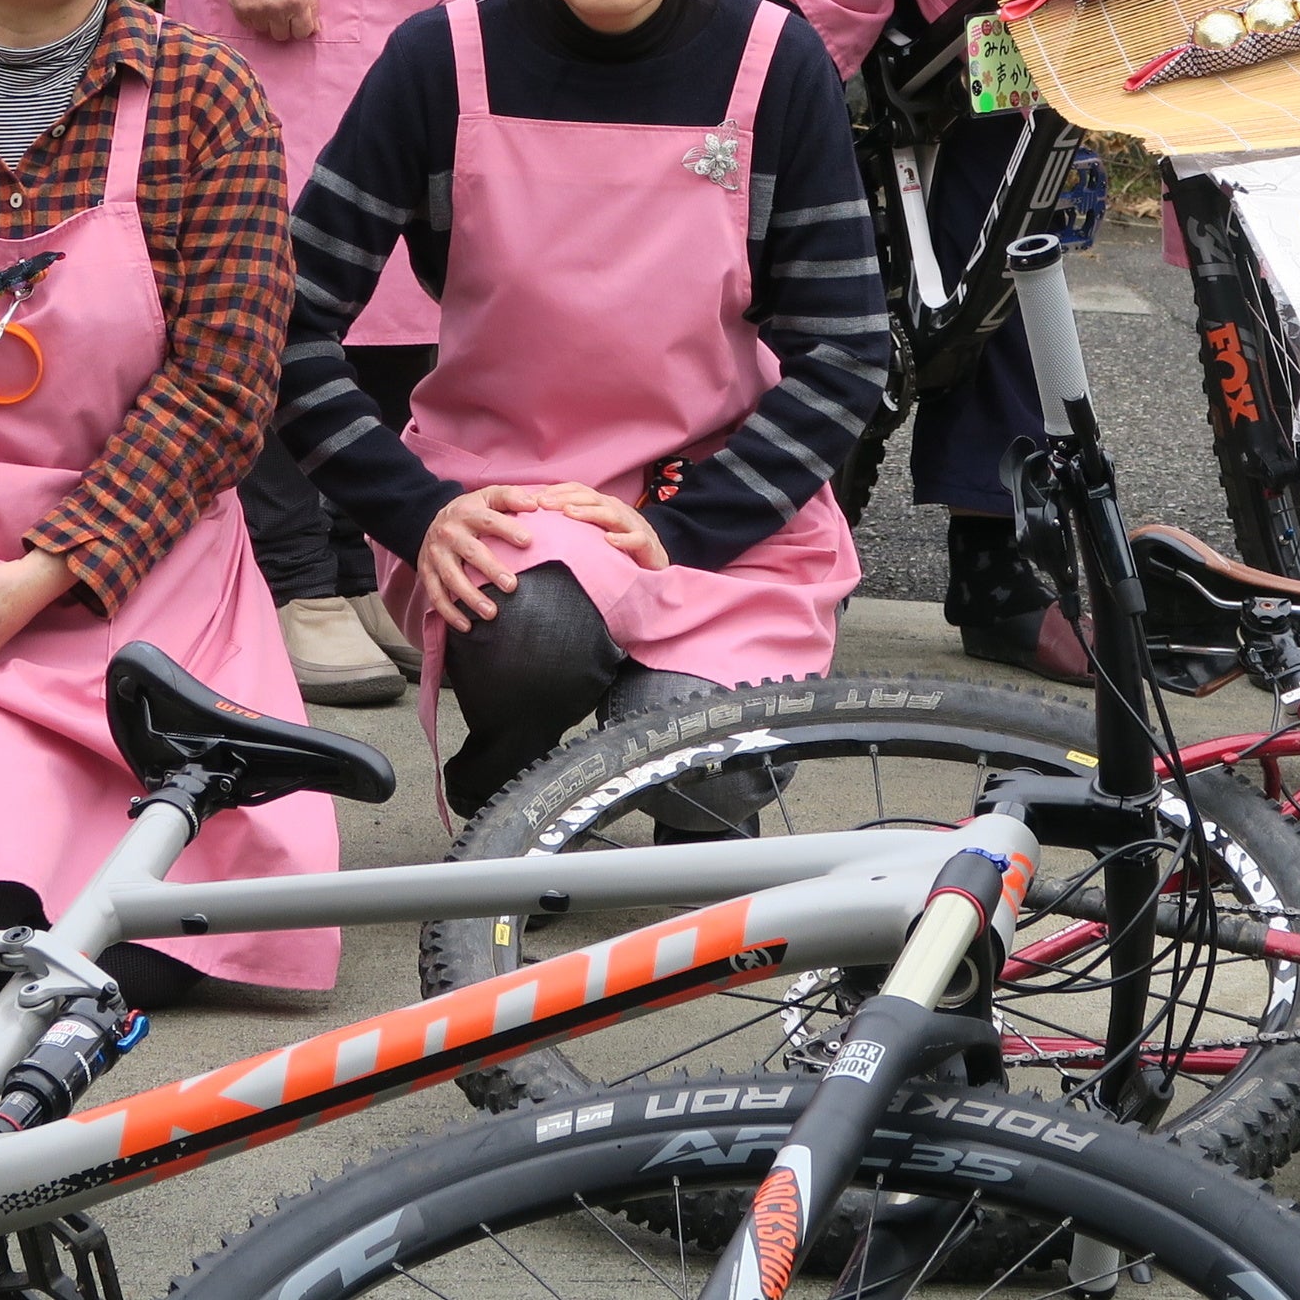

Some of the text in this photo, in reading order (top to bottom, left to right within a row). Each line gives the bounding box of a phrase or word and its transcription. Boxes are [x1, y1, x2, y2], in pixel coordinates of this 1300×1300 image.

[1206, 322, 1260, 428] FOX
[835, 687, 944, 711] FAT
[839, 1042, 880, 1062] ROCK
[828, 1060, 871, 1077] SHOX
[645, 1086, 1100, 1154] ROCKE RON
